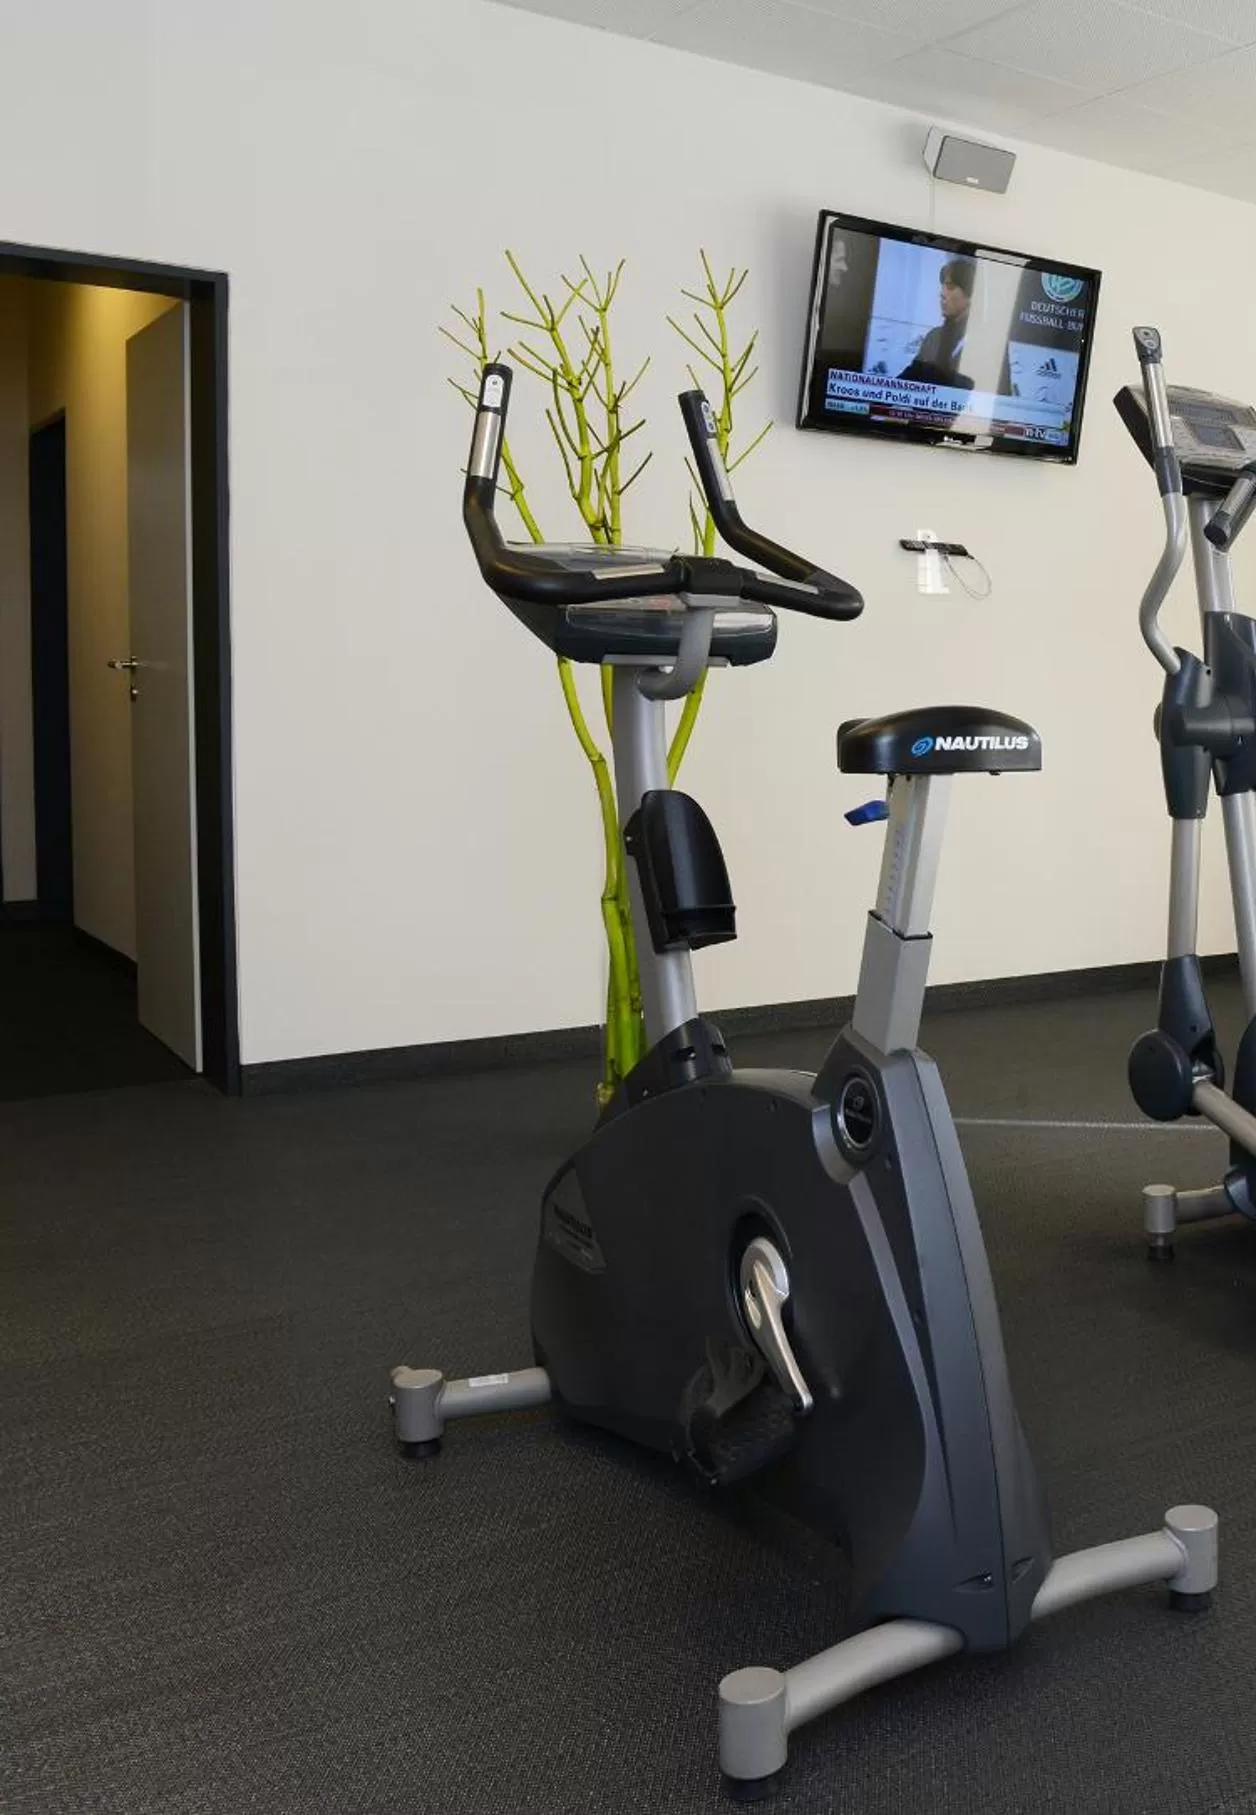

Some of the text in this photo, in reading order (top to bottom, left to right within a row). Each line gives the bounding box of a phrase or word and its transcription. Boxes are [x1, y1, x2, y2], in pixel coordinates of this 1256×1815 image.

[829, 382, 860, 397] Kroos
[862, 389, 883, 400] und
[885, 391, 911, 405] Poldi
[913, 397, 929, 407] auf
[931, 399, 948, 410] der
[935, 736, 1029, 751] NAUTILUS
